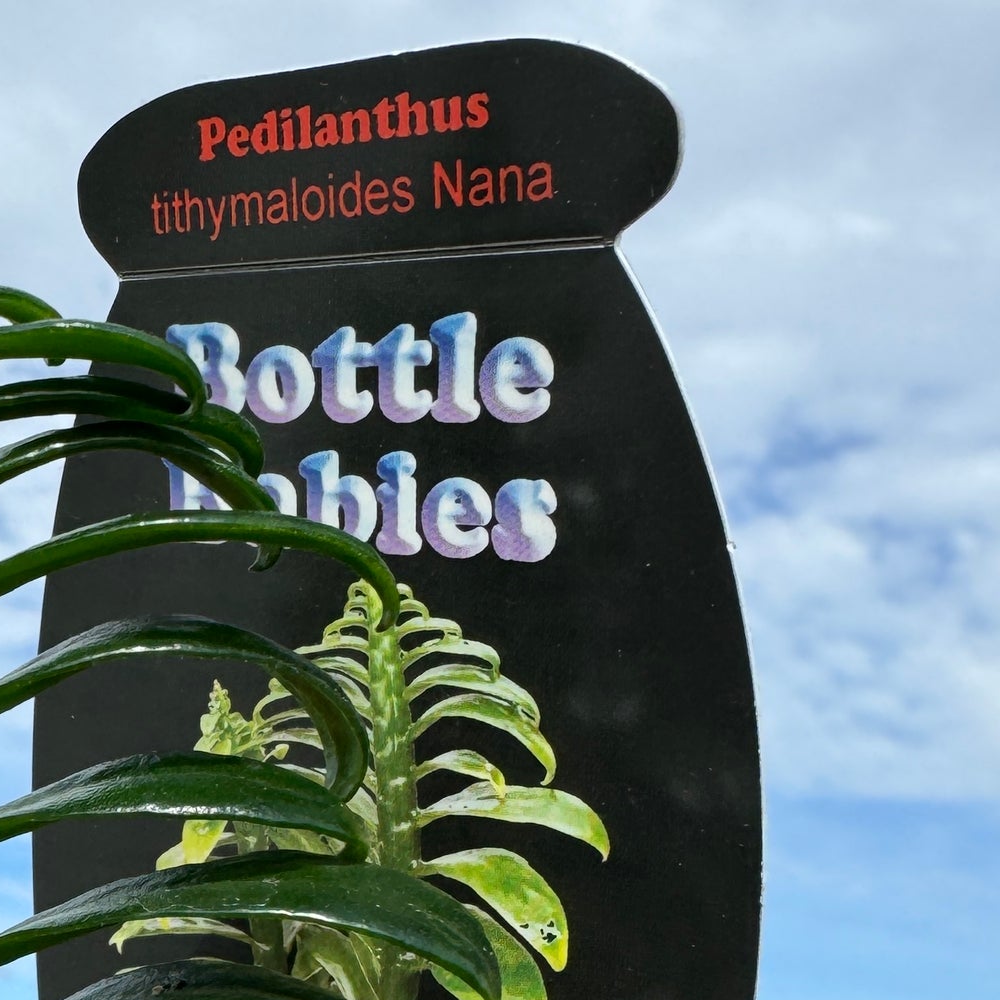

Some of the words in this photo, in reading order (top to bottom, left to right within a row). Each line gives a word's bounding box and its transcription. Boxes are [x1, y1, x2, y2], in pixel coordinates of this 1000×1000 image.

[198, 92, 490, 161] Pedilanthus
[151, 172, 416, 240] tithymaloides
[433, 160, 553, 208] Nana
[165, 311, 555, 423] Bottle
